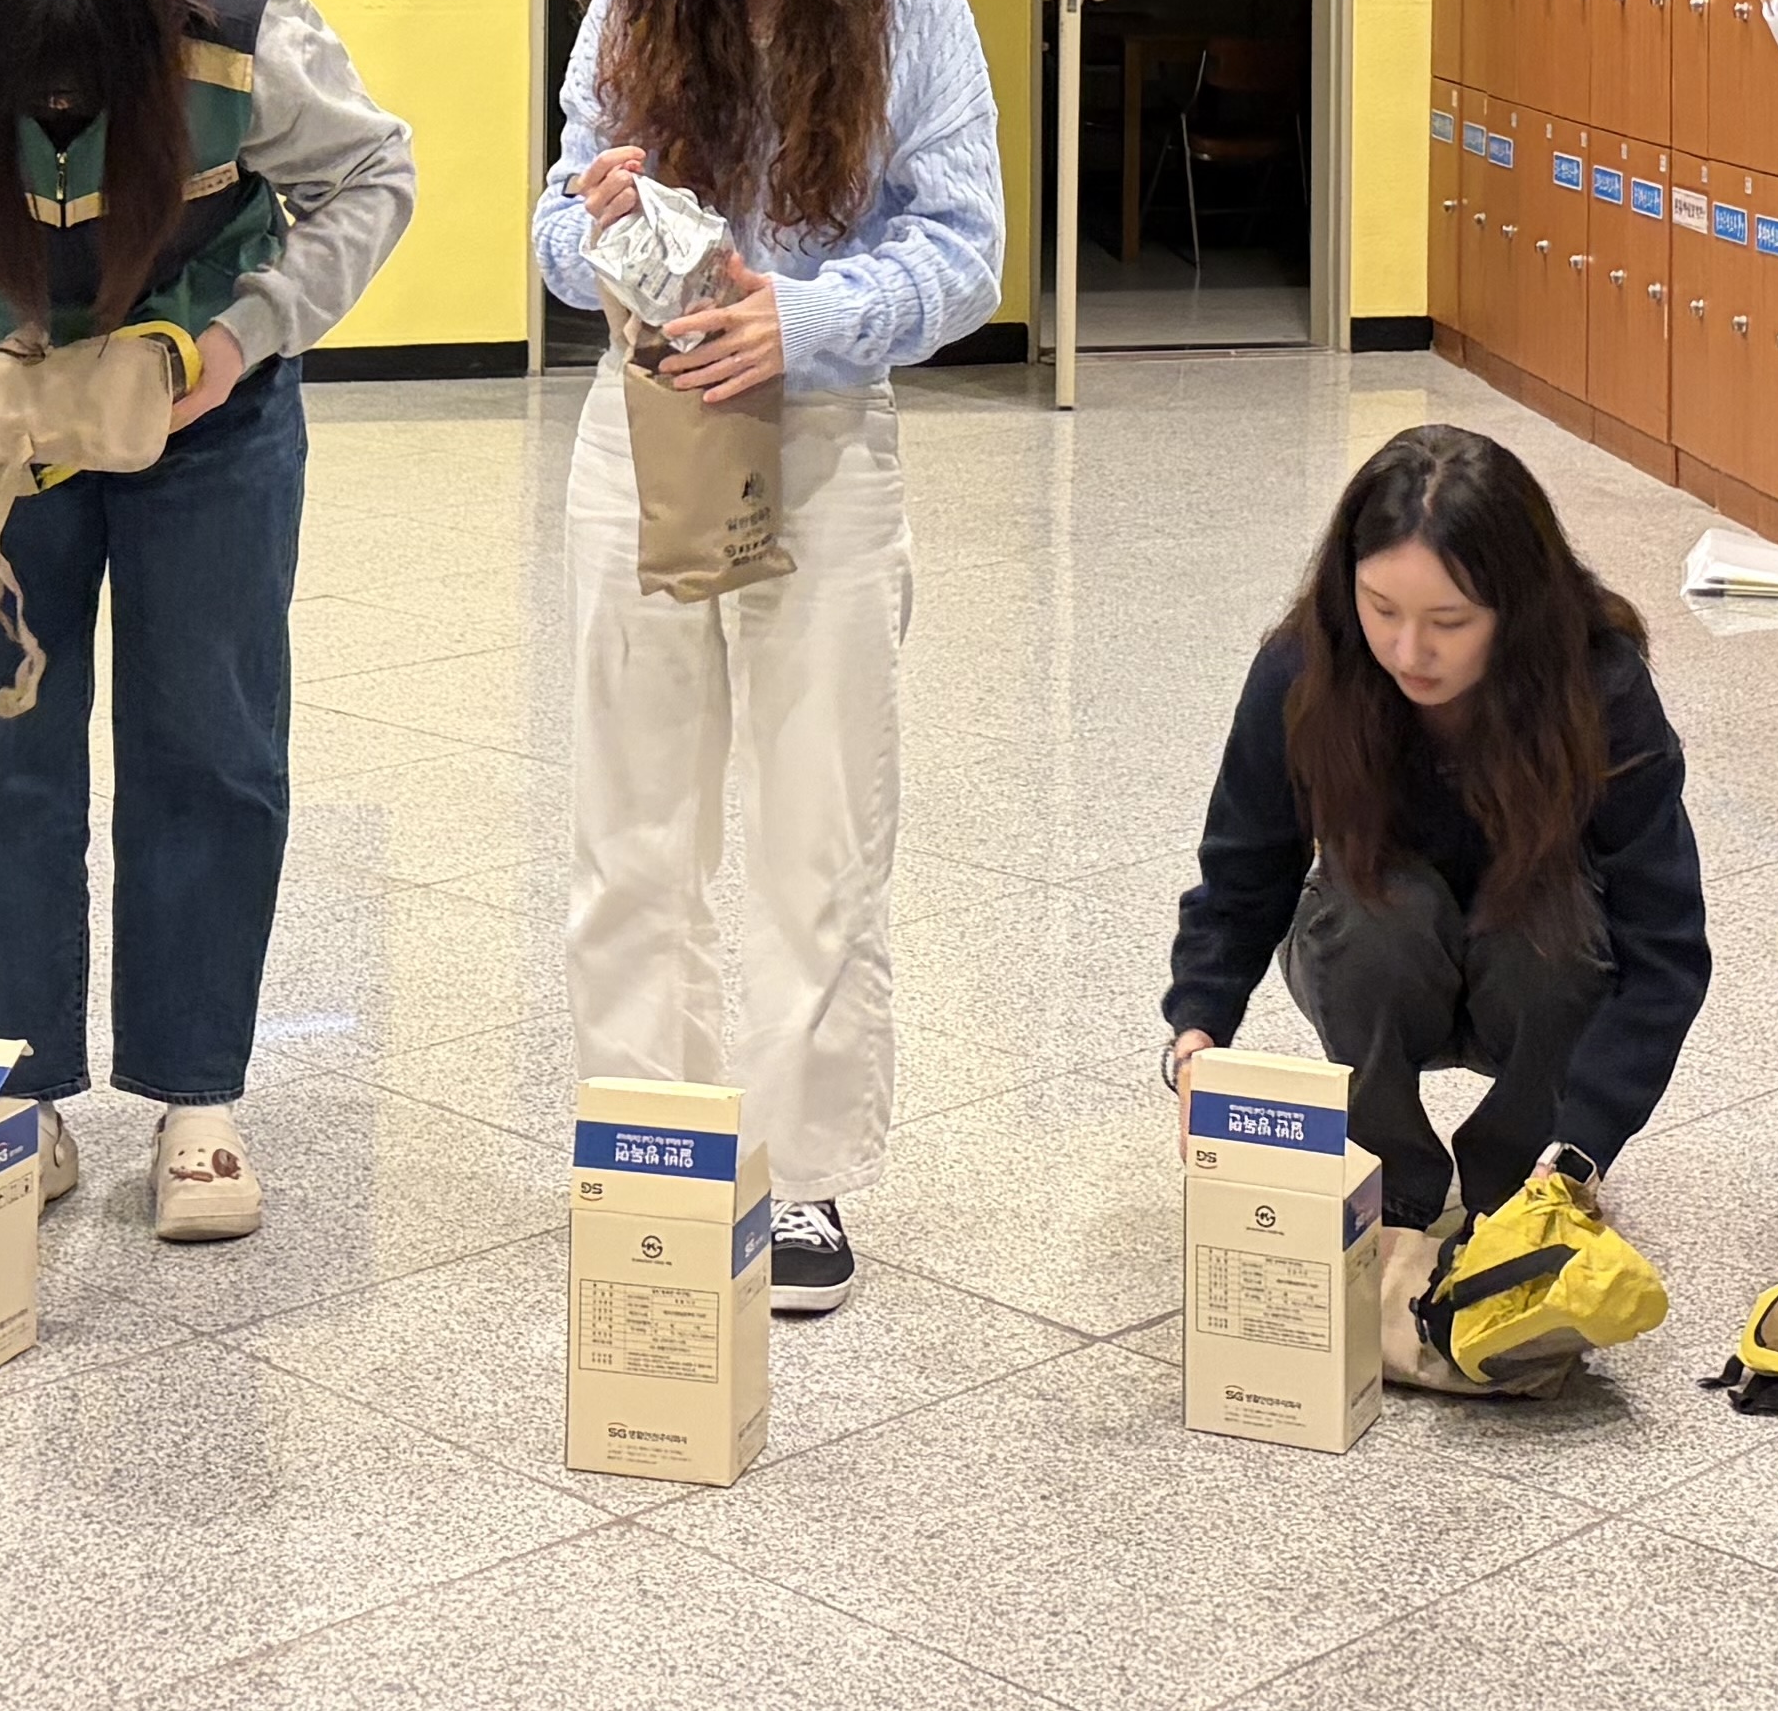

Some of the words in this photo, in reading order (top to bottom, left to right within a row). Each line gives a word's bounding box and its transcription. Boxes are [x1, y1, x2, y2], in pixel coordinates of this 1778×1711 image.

[1228, 1112, 1272, 1137] 방독면
[1275, 1118, 1304, 1141] 일반
[615, 1142, 660, 1165] 방독면
[663, 1147, 695, 1168] 일반
[581, 1182, 603, 1195] SG
